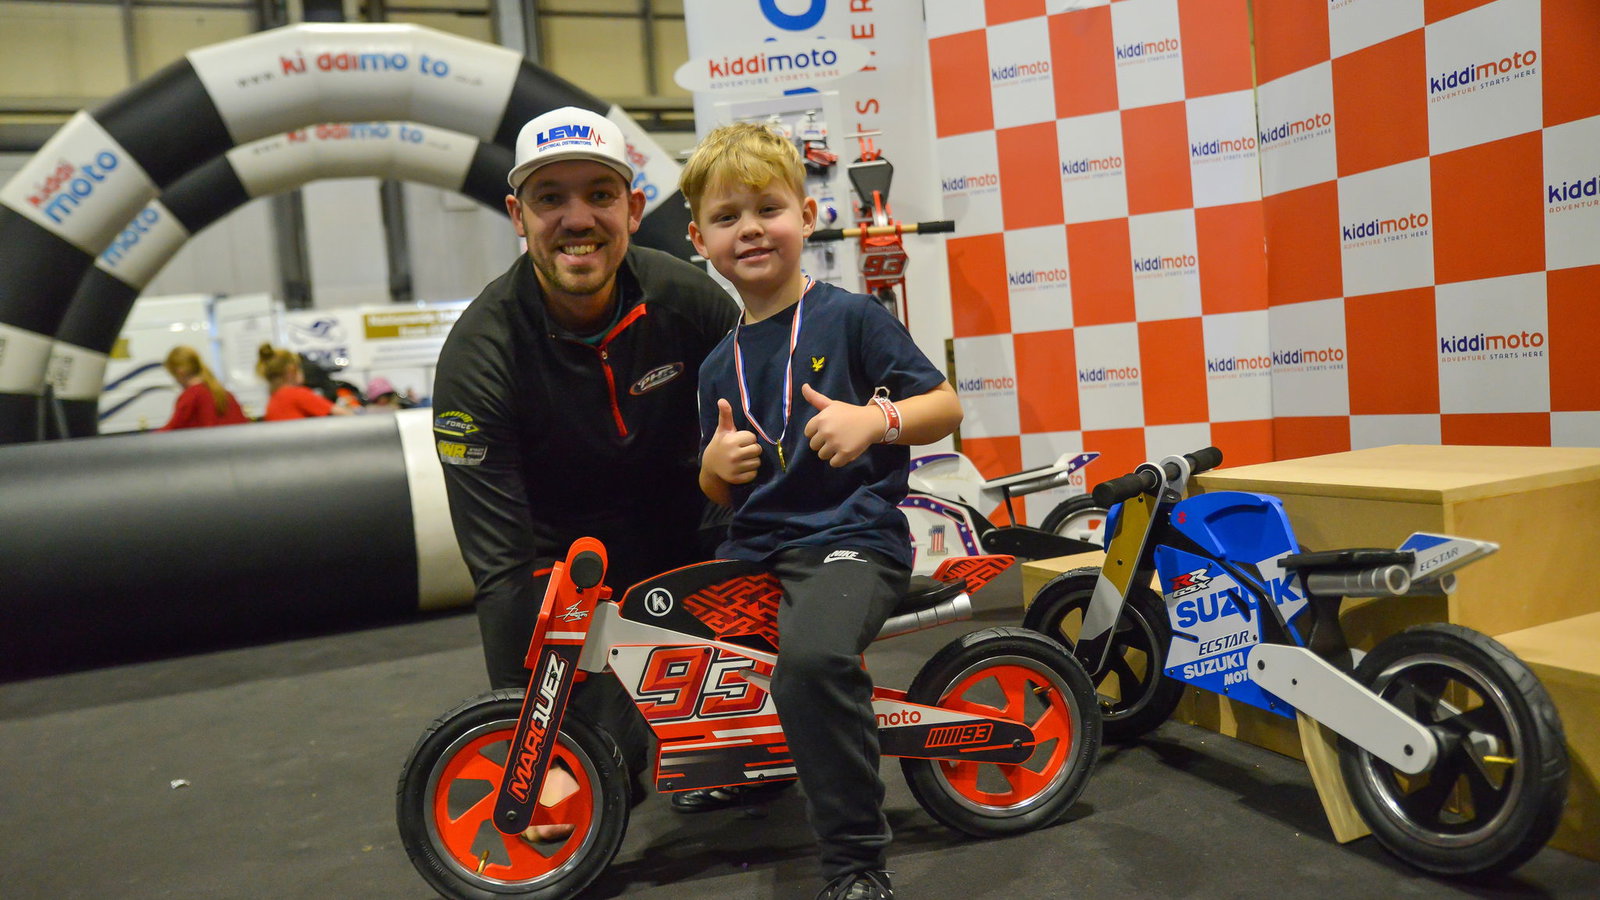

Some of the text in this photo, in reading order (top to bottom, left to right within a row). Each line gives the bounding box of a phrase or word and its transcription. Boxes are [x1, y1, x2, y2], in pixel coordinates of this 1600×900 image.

[1116, 38, 1179, 60] kiddimoto
[709, 49, 837, 78] kiddimoto
[991, 60, 1050, 81] kiddimoto
[1430, 50, 1537, 95] kiddimoto
[1431, 68, 1536, 103] ADVENTURE STARTS HERE
[537, 124, 590, 146] LEW
[1260, 113, 1332, 145] kiddimoto
[1191, 137, 1256, 157] kiddimoto
[1062, 156, 1122, 175] kiddimoto
[45, 152, 118, 224] moto
[942, 174, 998, 192] kiddimoto
[1343, 213, 1429, 241] kiddimoto
[1410, 230, 1428, 238] HERE
[1134, 255, 1196, 273] kiddimoto
[1009, 268, 1068, 286] kiddimoto
[1440, 330, 1544, 354] kiddimoto
[1207, 355, 1271, 373] kiddimoto
[1272, 347, 1344, 366] kiddimoto
[1441, 350, 1543, 363] ADVENTURE STARTS HERE
[958, 377, 1014, 391] kiddimoto
[1079, 367, 1139, 383] kiddimoto
[446, 420, 472, 430] FORCE
[829, 549, 859, 558] NIKE
[1420, 547, 1458, 571] ECSTAR
[1199, 630, 1250, 656] ECSTAR
[1183, 652, 1245, 680] SUZUKI
[637, 645, 767, 724] 93
[511, 653, 566, 800] MARQUEZ
[961, 724, 993, 744] 93
